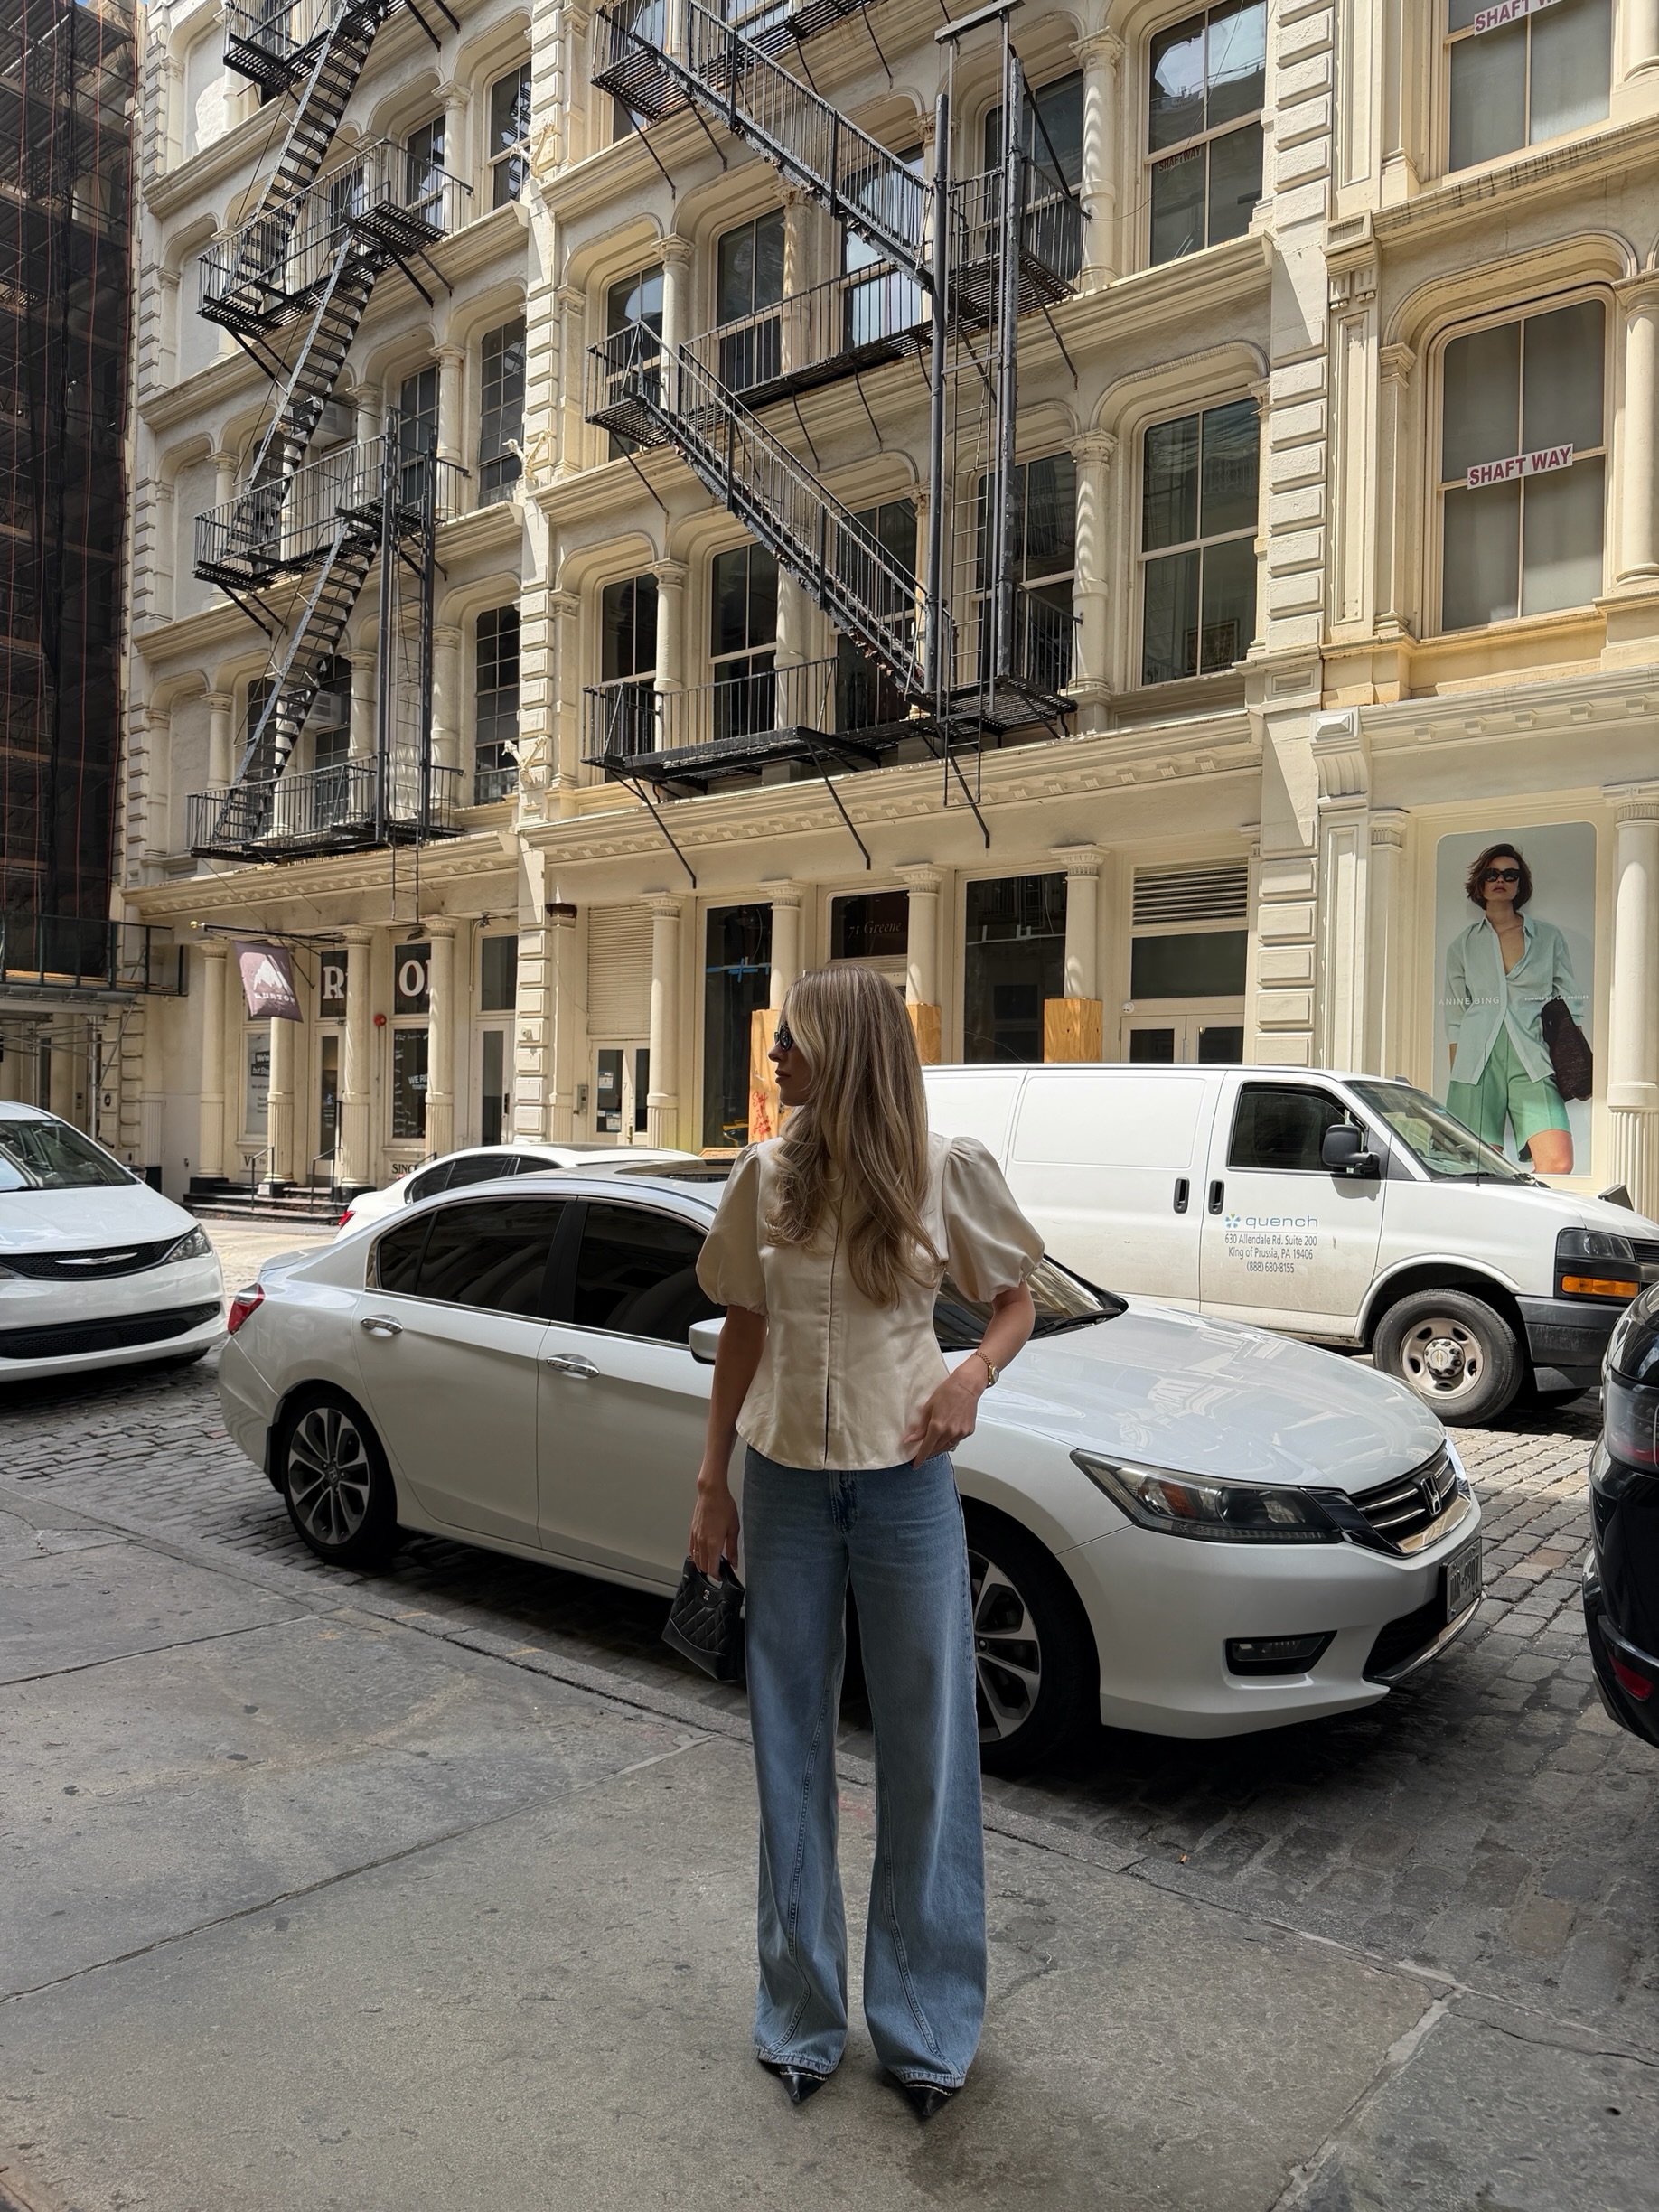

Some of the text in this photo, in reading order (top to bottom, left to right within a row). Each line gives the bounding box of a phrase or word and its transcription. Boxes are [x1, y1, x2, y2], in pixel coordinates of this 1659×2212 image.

[1476, 0, 1529, 31] SHAFT
[1469, 446, 1571, 486] SHAFT WAY
[864, 920, 902, 934] Greene
[323, 965, 348, 999] R
[1439, 996, 1500, 1006] ANINE BING
[408, 1075, 419, 1084] WE
[1245, 1215, 1318, 1229] quench
[1224, 1233, 1317, 1246] 630 Allendale Rd. Suite 200
[1228, 1246, 1314, 1260] King of Prussia, PA 19406
[1246, 1261, 1295, 1273] (888) 680-8155
